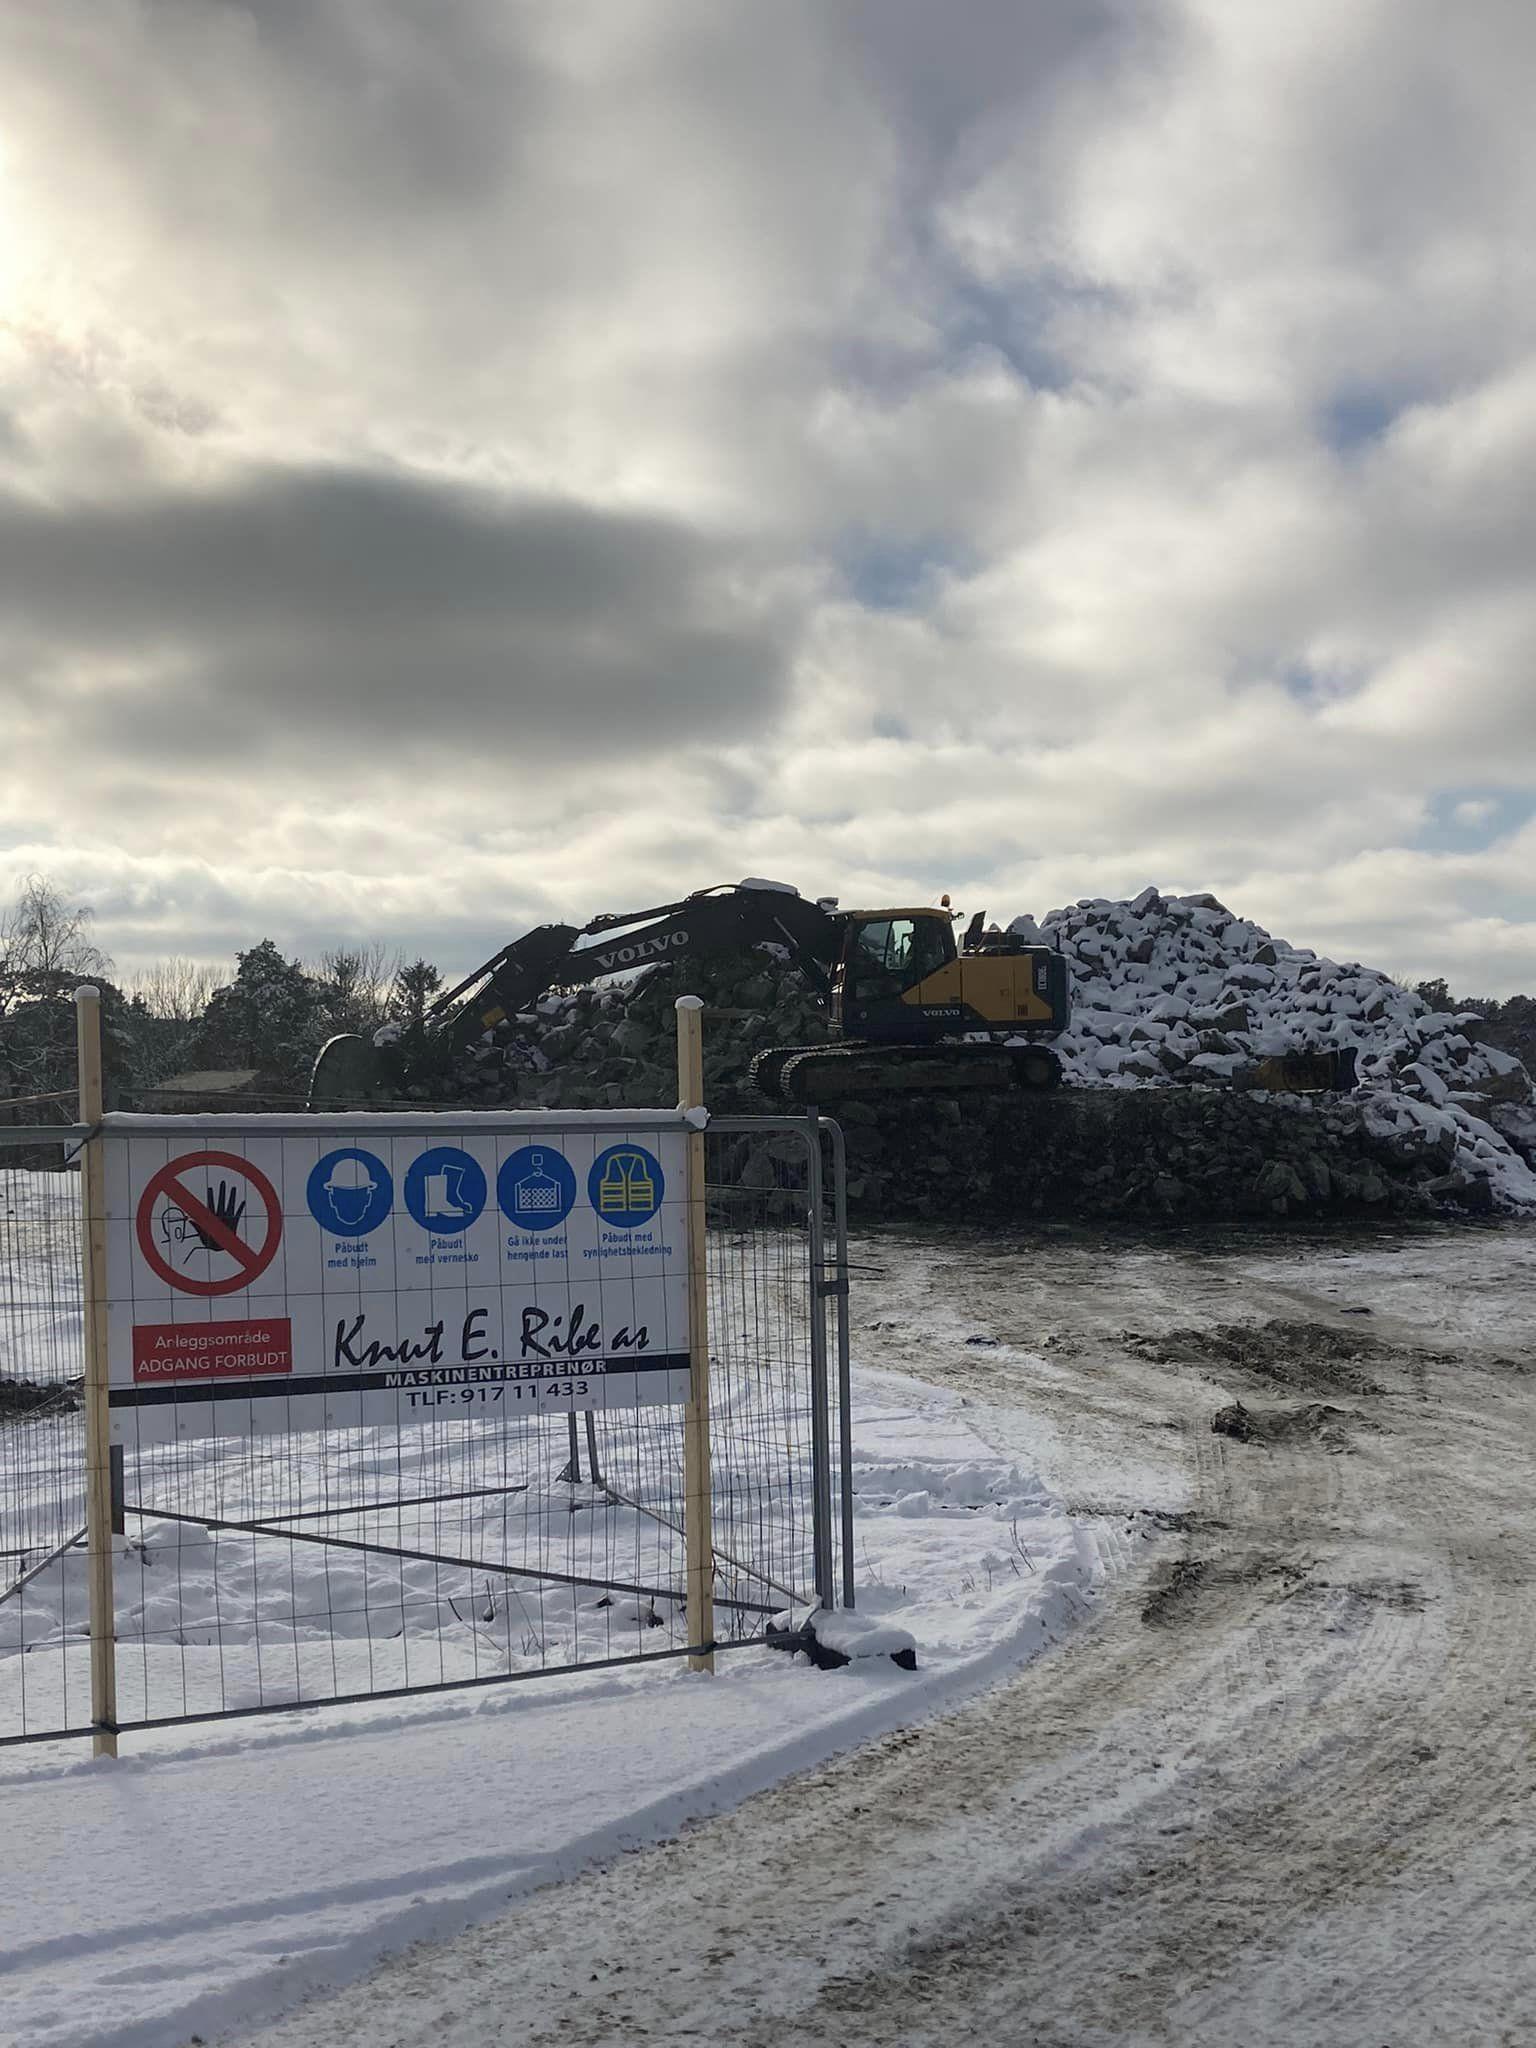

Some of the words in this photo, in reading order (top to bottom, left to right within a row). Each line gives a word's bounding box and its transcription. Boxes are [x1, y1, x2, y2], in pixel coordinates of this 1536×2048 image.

[594, 931, 689, 969] VOLVO
[922, 1009, 960, 1017] VOLVO
[508, 1236, 519, 1247] Gå
[522, 1235, 540, 1246] ikke
[542, 1234, 568, 1245] under
[603, 1231, 632, 1243] Påbudt
[635, 1231, 652, 1241] med
[335, 1242, 368, 1253] Påbudt
[431, 1238, 463, 1250] Påbudt
[416, 1255, 434, 1264] med
[438, 1252, 478, 1263] vernesko
[507, 1249, 549, 1261] hengende
[552, 1247, 568, 1258] last
[328, 1258, 347, 1268] med
[334, 1314, 444, 1367] Knut
[461, 1308, 498, 1361] E.
[520, 1303, 601, 1357] Ribe
[611, 1325, 650, 1350] as
[138, 1356, 210, 1373] ADGANG
[215, 1351, 288, 1368] FORBUDT
[384, 1360, 607, 1387] MASKINENTREPRENØR
[513, 1384, 538, 1399] 11
[546, 1380, 589, 1398] 433
